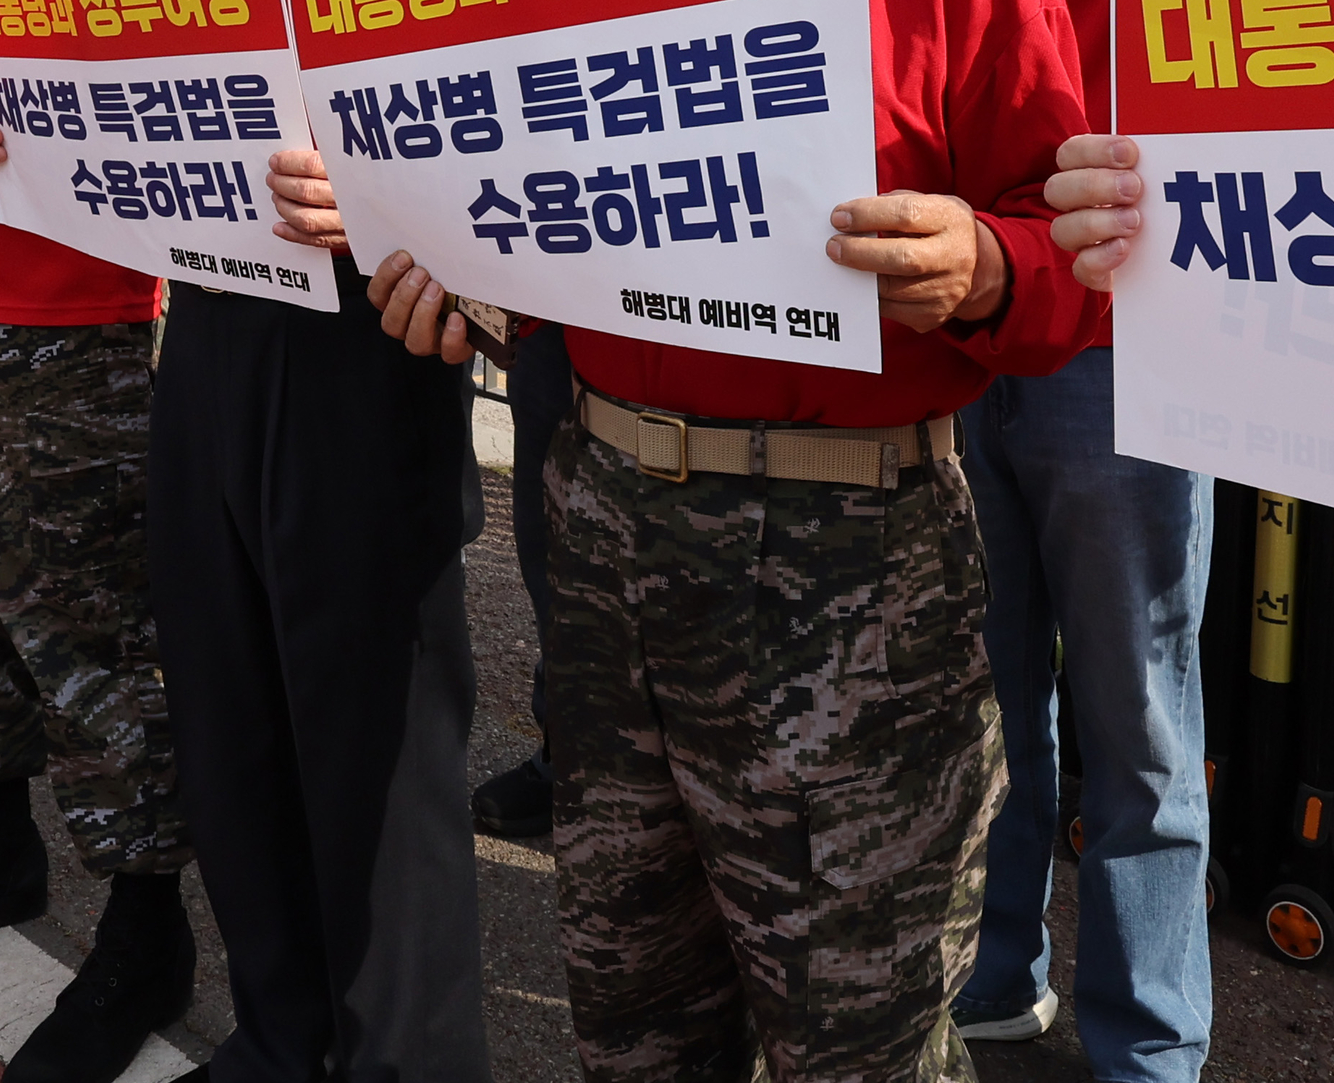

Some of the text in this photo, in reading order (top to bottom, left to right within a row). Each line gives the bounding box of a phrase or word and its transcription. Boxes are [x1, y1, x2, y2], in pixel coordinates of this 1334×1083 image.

[88, 74, 282, 142] 특검법을
[330, 19, 830, 161] 채상병 특검법을
[70, 158, 259, 222] 수용하라!
[467, 151, 770, 255] 수용하라!
[169, 247, 311, 293] 해병대 예비역 연대
[620, 288, 841, 342] 해병대 예비역 연대
